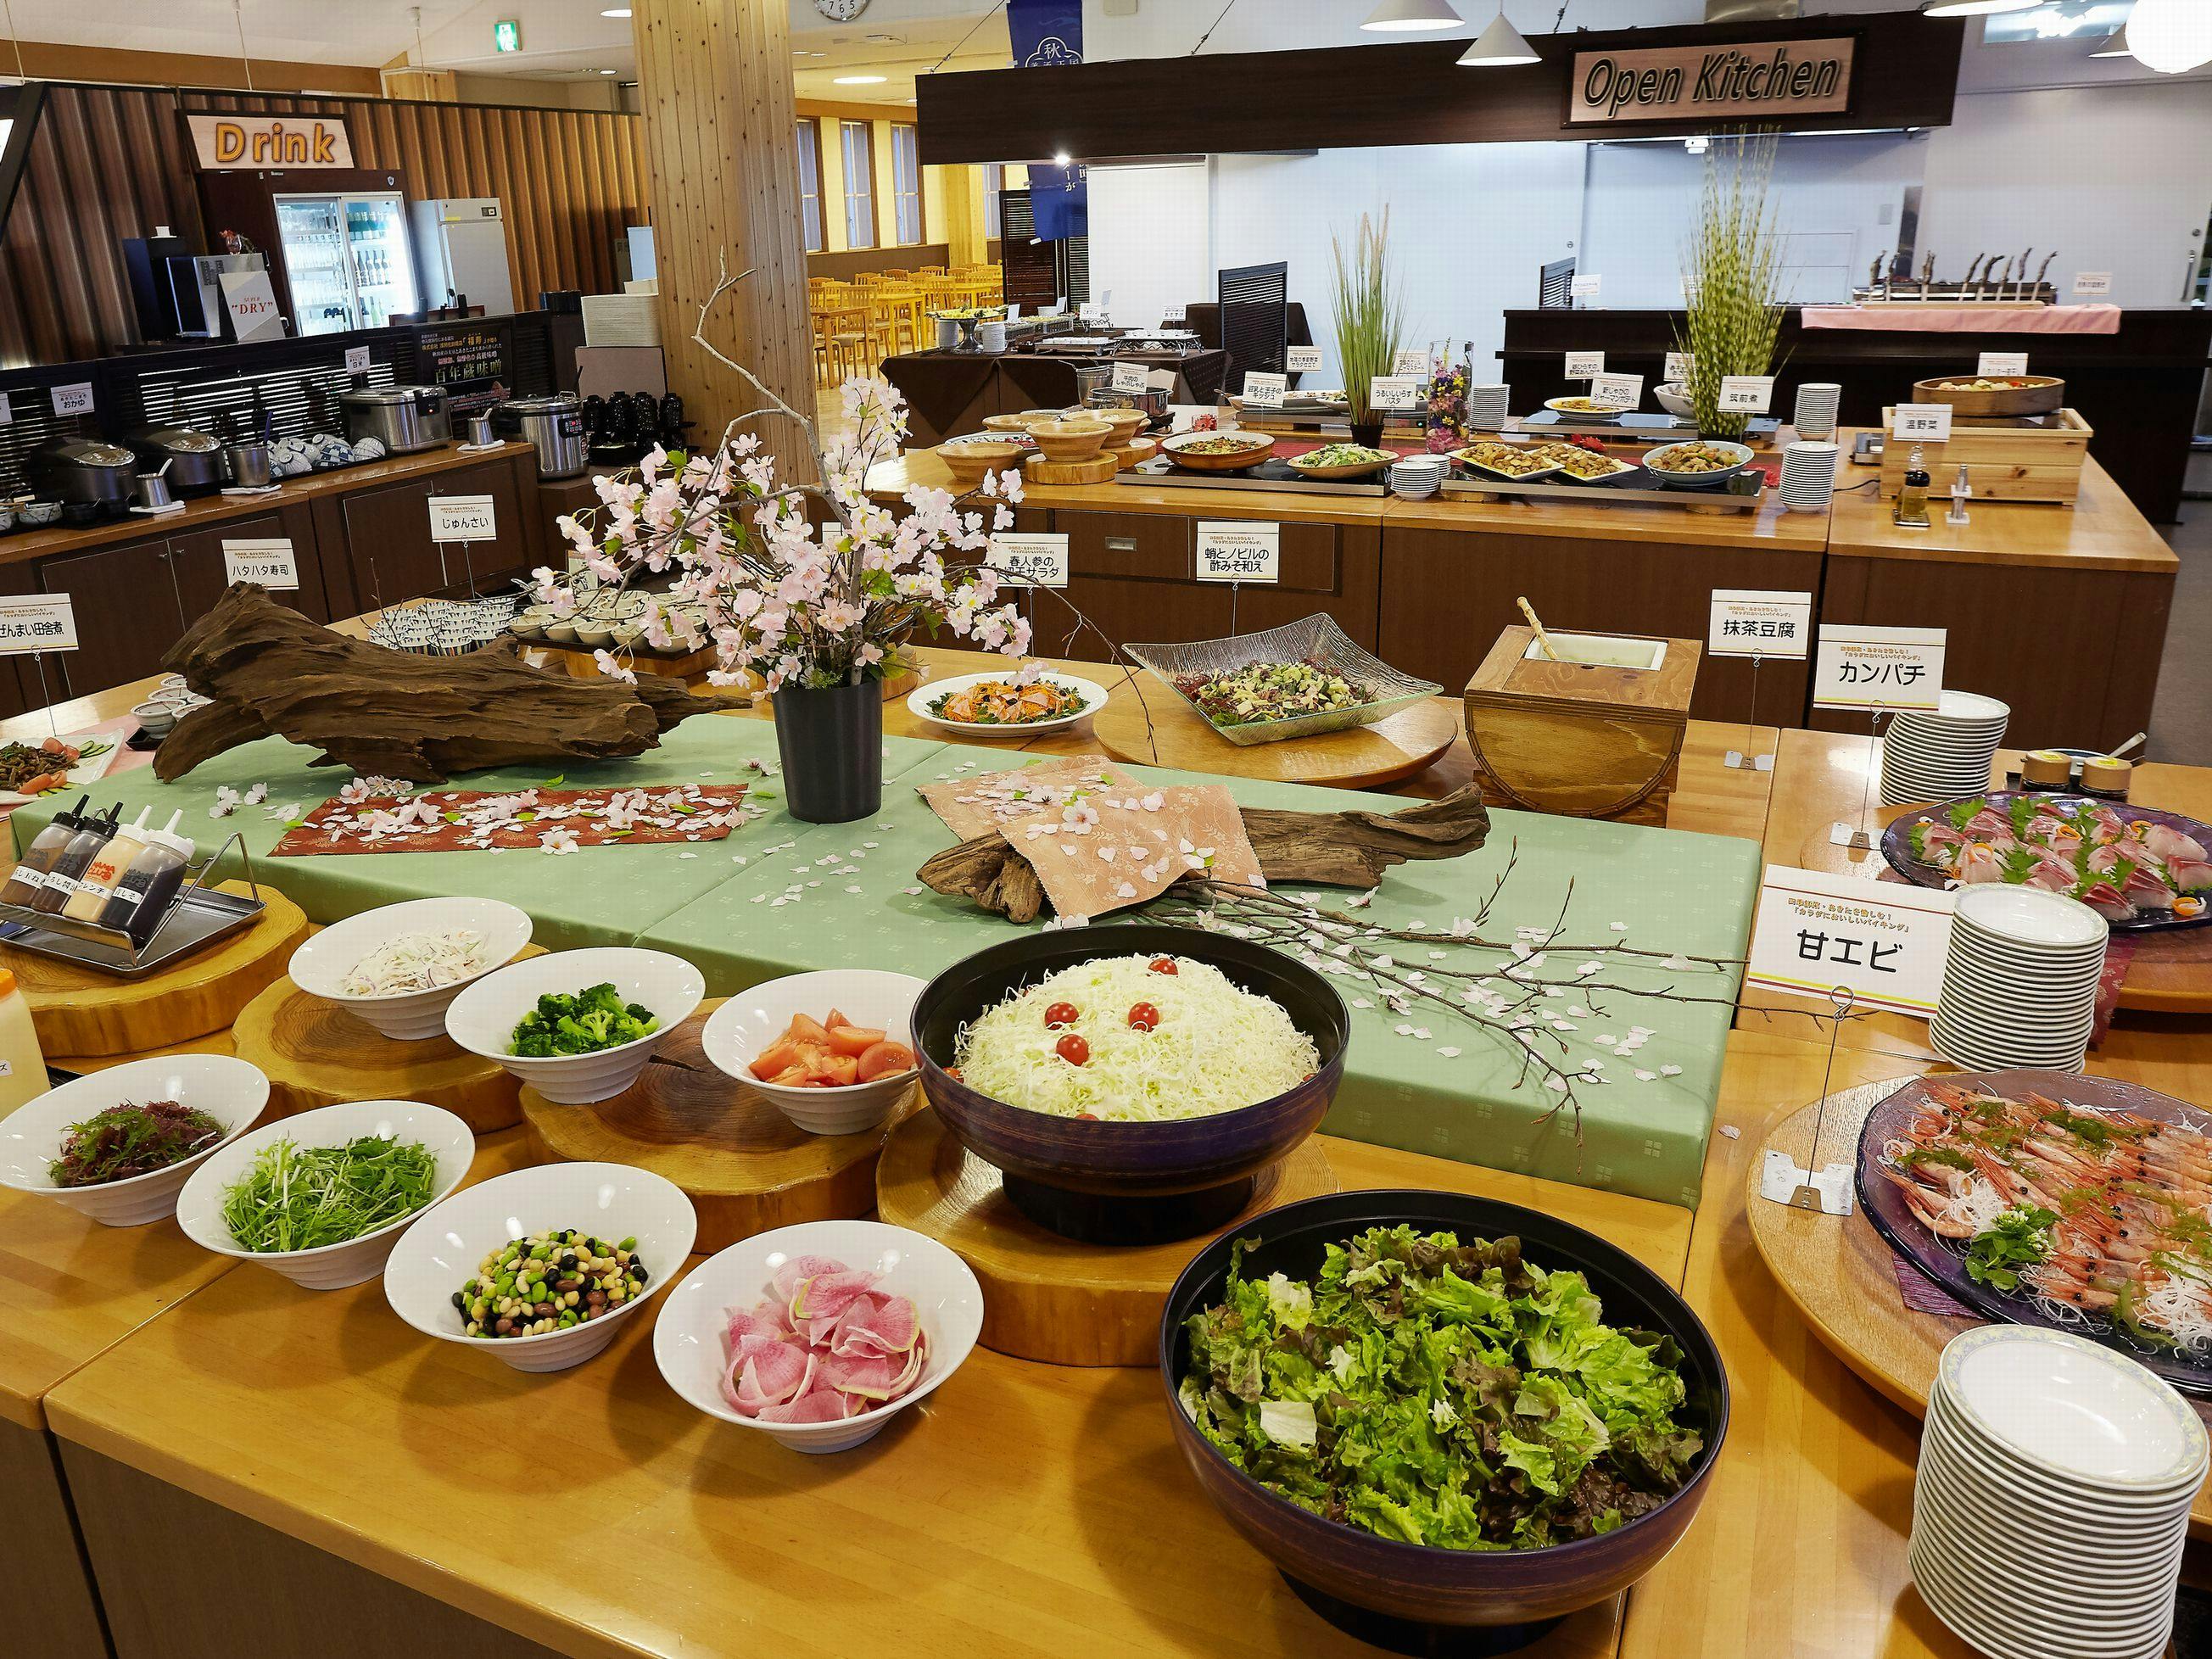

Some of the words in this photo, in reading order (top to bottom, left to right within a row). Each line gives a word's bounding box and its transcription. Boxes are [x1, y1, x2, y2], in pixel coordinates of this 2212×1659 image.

[1044, 42, 1062, 59] 秋
[1584, 57, 1683, 119] Open
[1691, 47, 1840, 103] Kitchen
[215, 122, 335, 163] Drink
[64, 399, 86, 409] おかゆ
[442, 517, 489, 529] じゅんさい
[1204, 547, 1270, 561] 蛸とノビルの
[1008, 556, 1054, 567] 春人参の
[1209, 560, 1264, 573] 酢みそ和え
[232, 564, 289, 577] ハタハタ寿司
[1723, 619, 1796, 639] 抹茶豆腐
[1839, 661, 1926, 686] カンパチ
[80, 882, 104, 894] フレンチ
[1796, 929, 1903, 973] 甘エビ
